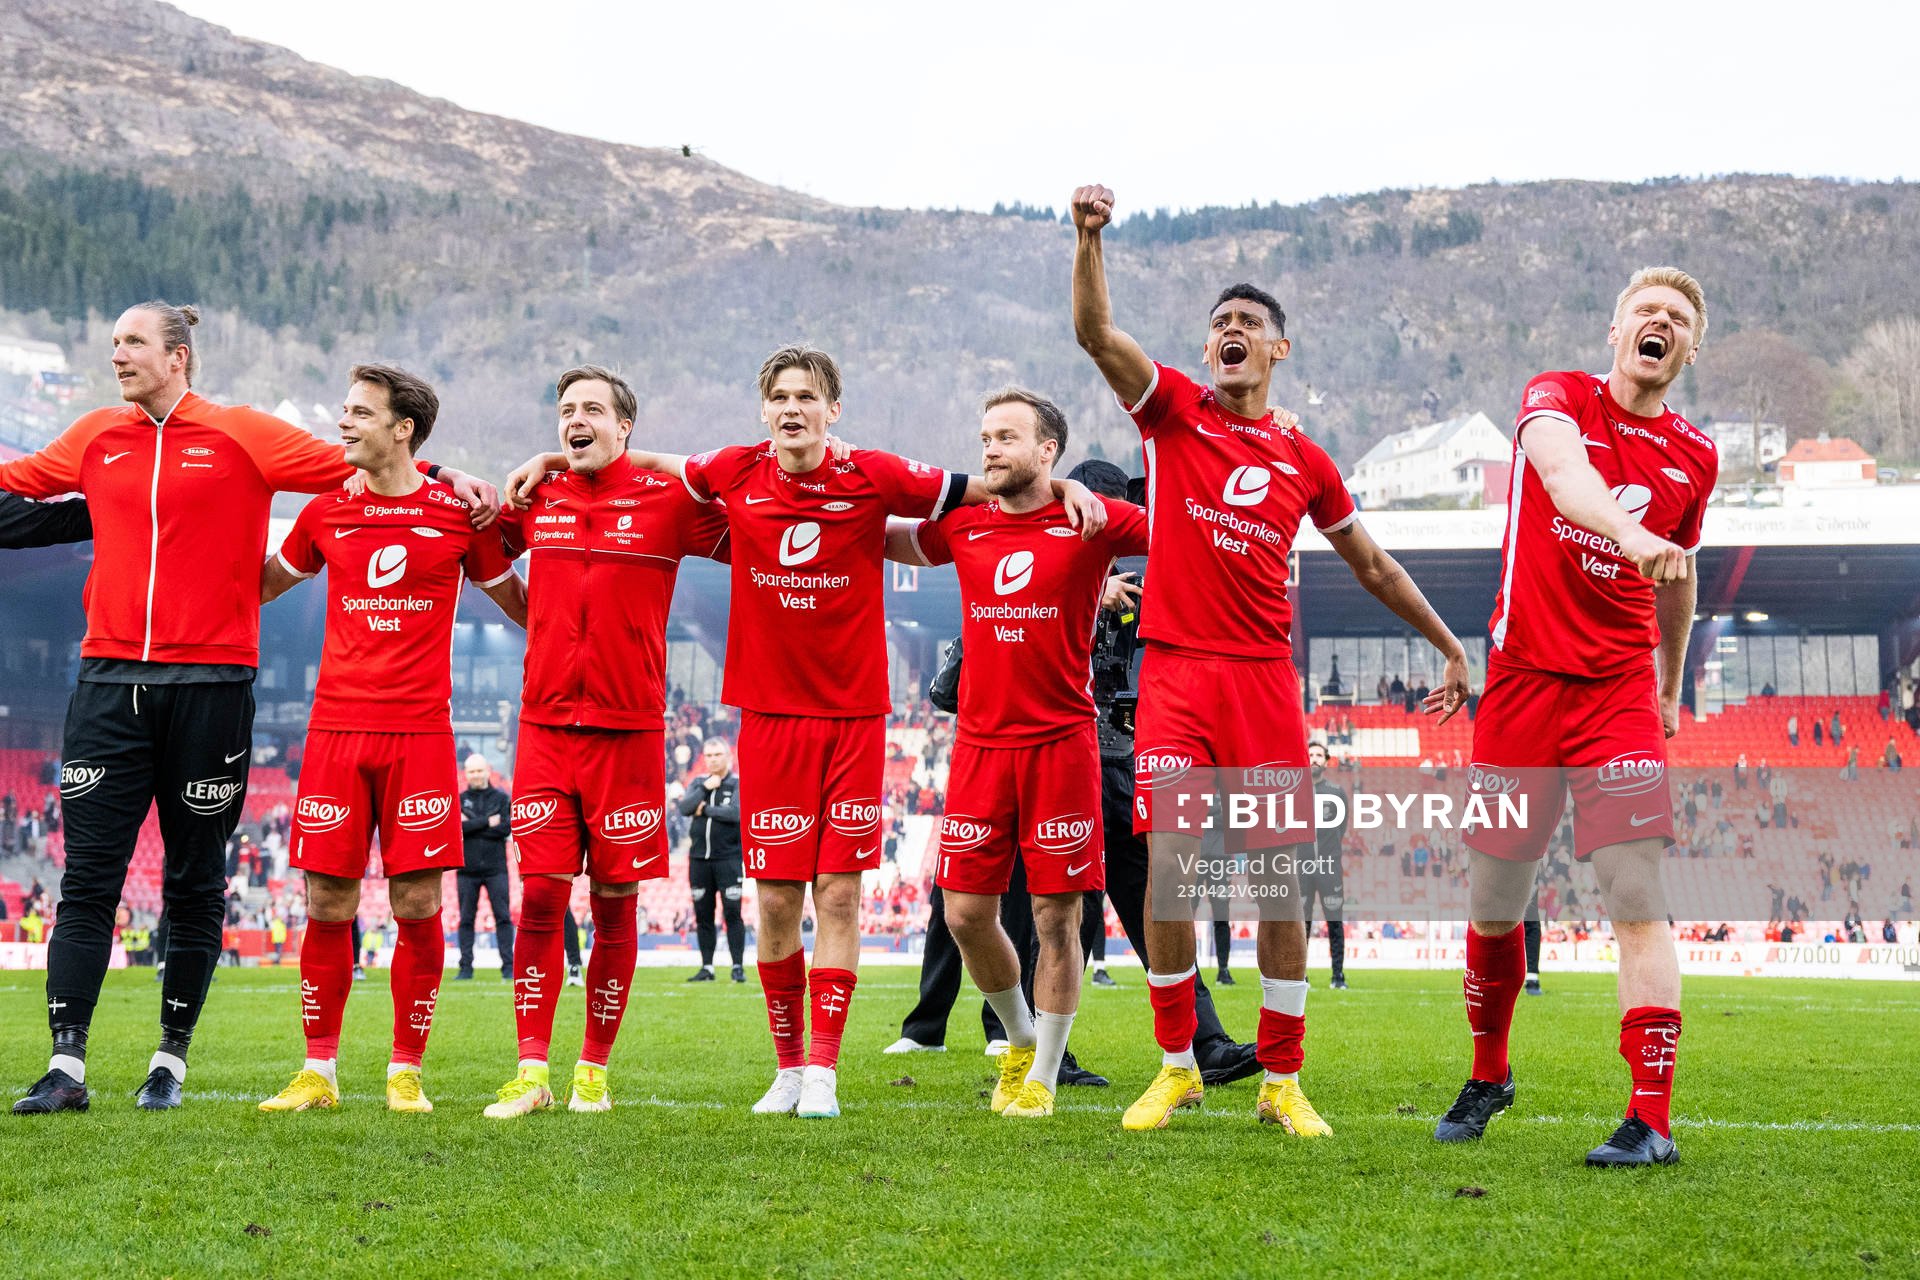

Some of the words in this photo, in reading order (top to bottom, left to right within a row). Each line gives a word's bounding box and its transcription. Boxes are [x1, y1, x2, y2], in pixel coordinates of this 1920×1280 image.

[1618, 422, 1668, 448] Fjordkraft
[376, 506, 423, 516] Fjordkraft
[444, 496, 469, 509] BOB
[1185, 497, 1280, 545] Sparebanken
[541, 531, 575, 540] Fjordkraft
[604, 530, 643, 540] Sparebanken
[1213, 529, 1250, 555] Vest
[1550, 516, 1625, 557] Spareba
[1581, 552, 1620, 579] Vest
[751, 567, 849, 588] Sparebanken
[341, 594, 433, 614] Sparebanken
[779, 592, 816, 609] Vest
[970, 602, 1058, 622] Sparebanken
[367, 615, 401, 631] Vest
[994, 625, 1025, 642] Vest
[1135, 754, 1189, 774] LERØY
[1598, 759, 1665, 783] LERØY
[61, 767, 102, 784] ERØY
[1243, 768, 1301, 788] LERØY
[186, 781, 240, 800] LERØY
[298, 798, 346, 821] LERØY
[398, 796, 450, 817] LERØY
[511, 800, 552, 820] ERØY
[1136, 796, 1148, 820] 6
[604, 808, 660, 831] LERØY
[751, 813, 811, 831] LERØY
[1037, 820, 1092, 839] LERØY
[748, 848, 766, 870] 18
[514, 966, 546, 1016] tide
[592, 979, 624, 1025] tide
[1641, 1023, 1680, 1075] tid
